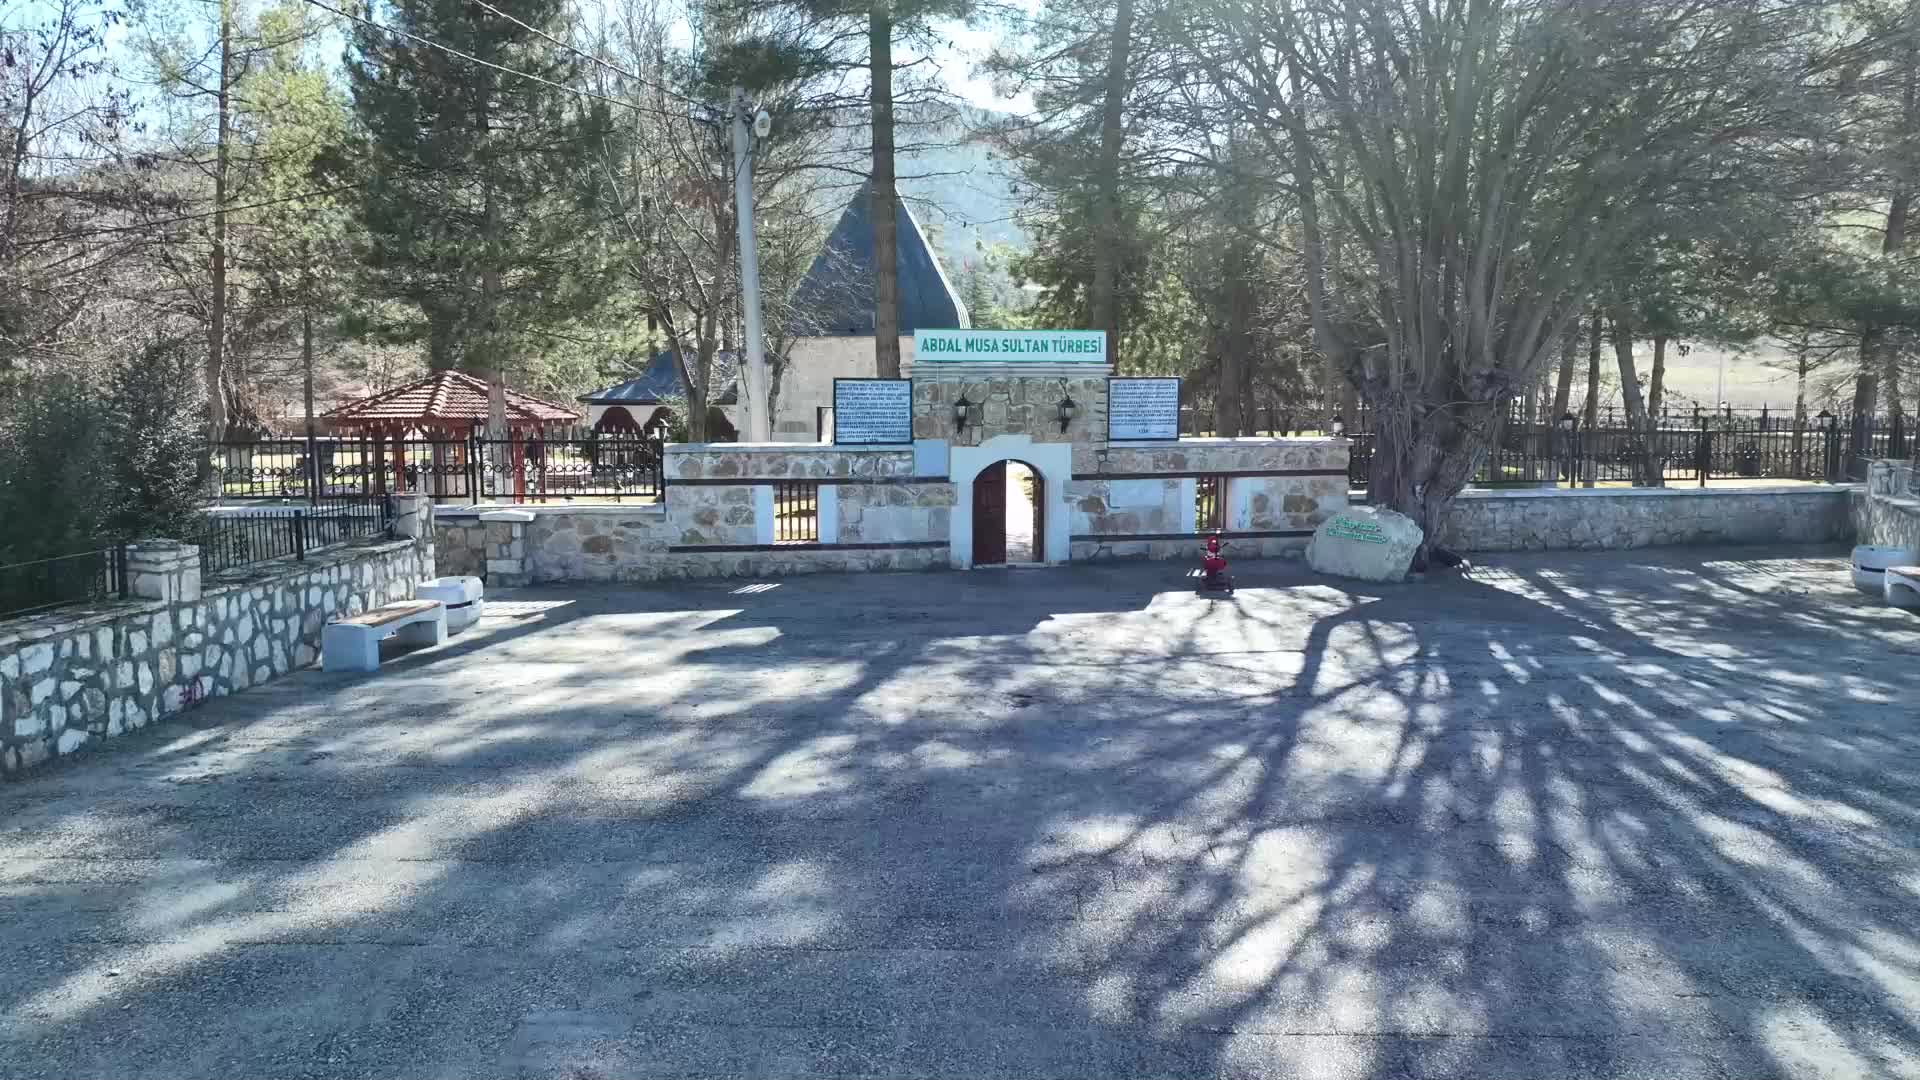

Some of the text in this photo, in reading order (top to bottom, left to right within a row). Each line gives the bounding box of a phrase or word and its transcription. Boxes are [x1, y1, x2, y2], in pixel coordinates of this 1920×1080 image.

[921, 336, 1102, 354] ABDAL MUSA SULTAN TÜRBESİ
